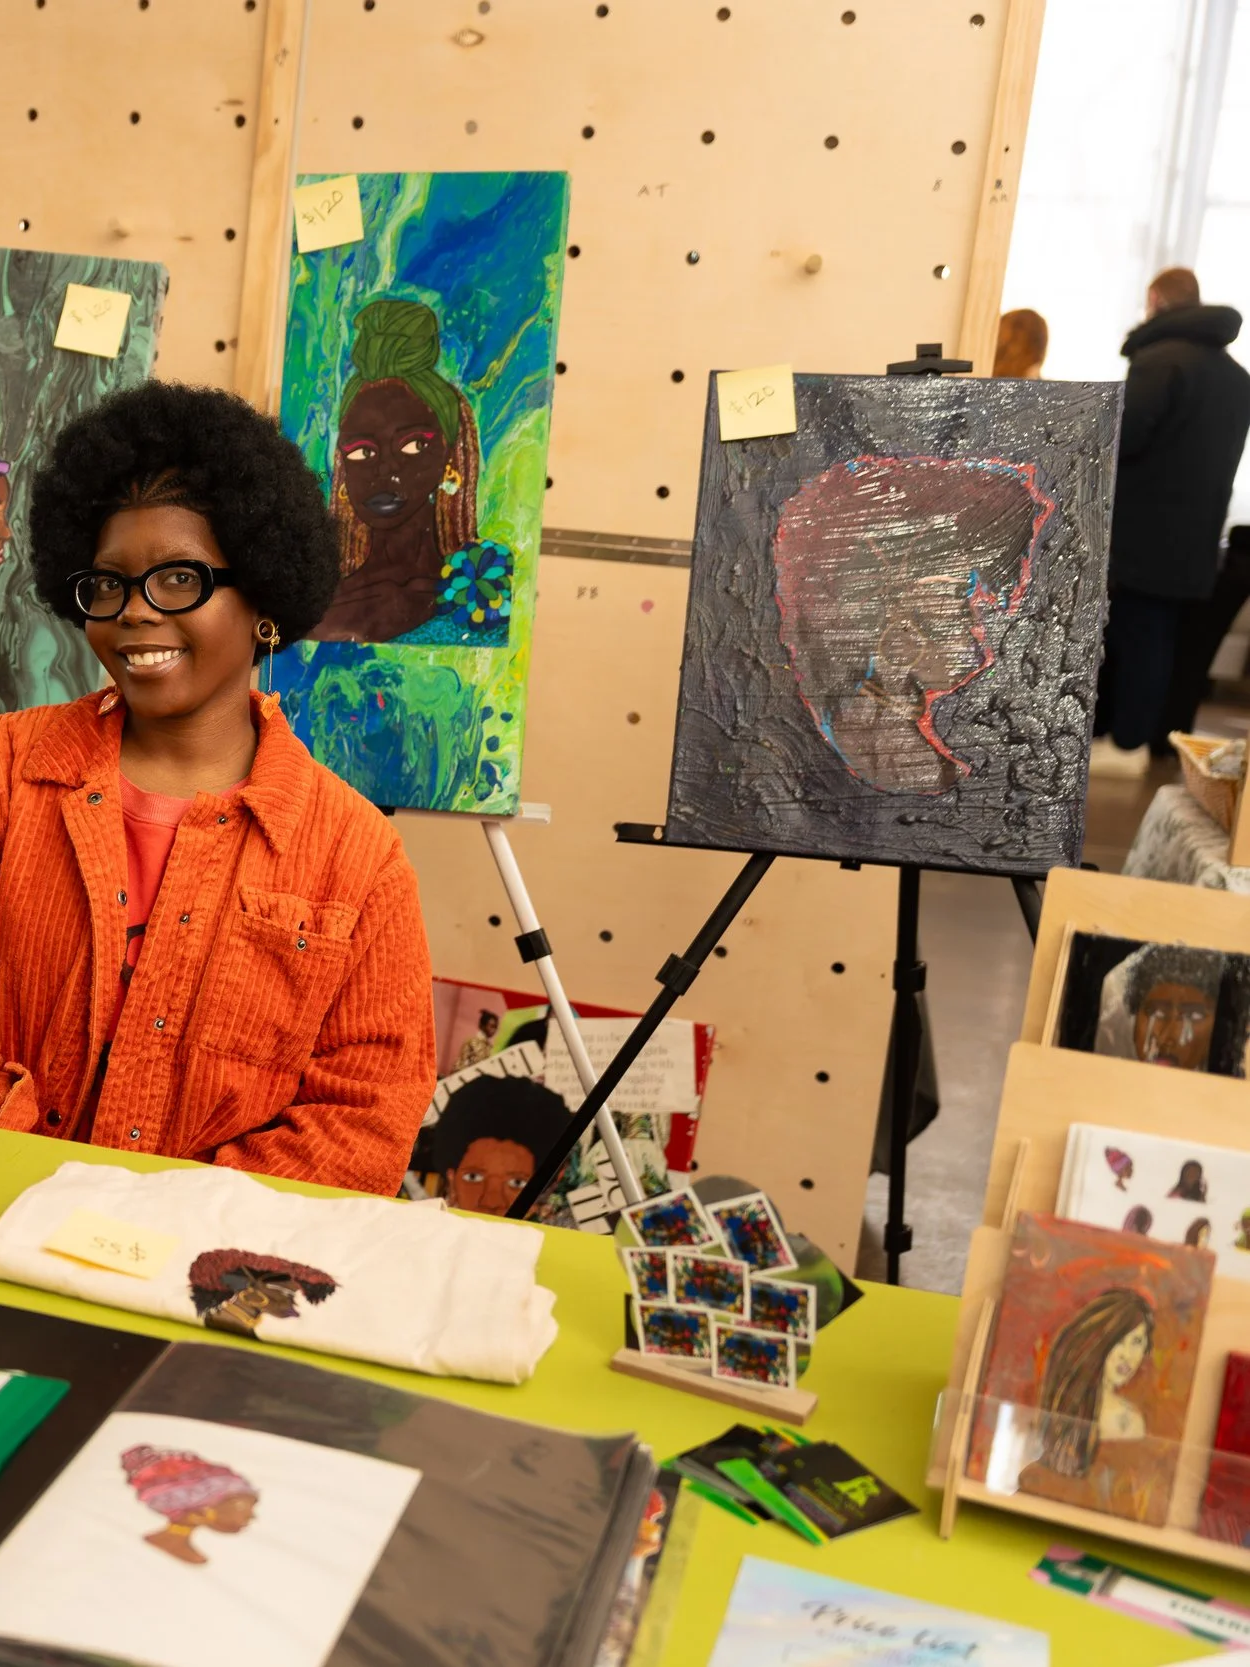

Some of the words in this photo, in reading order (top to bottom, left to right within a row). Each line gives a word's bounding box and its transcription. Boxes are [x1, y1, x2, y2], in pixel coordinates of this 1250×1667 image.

[301, 189, 344, 225] $120
[729, 385, 776, 416] $120
[800, 1599, 899, 1638] Price
